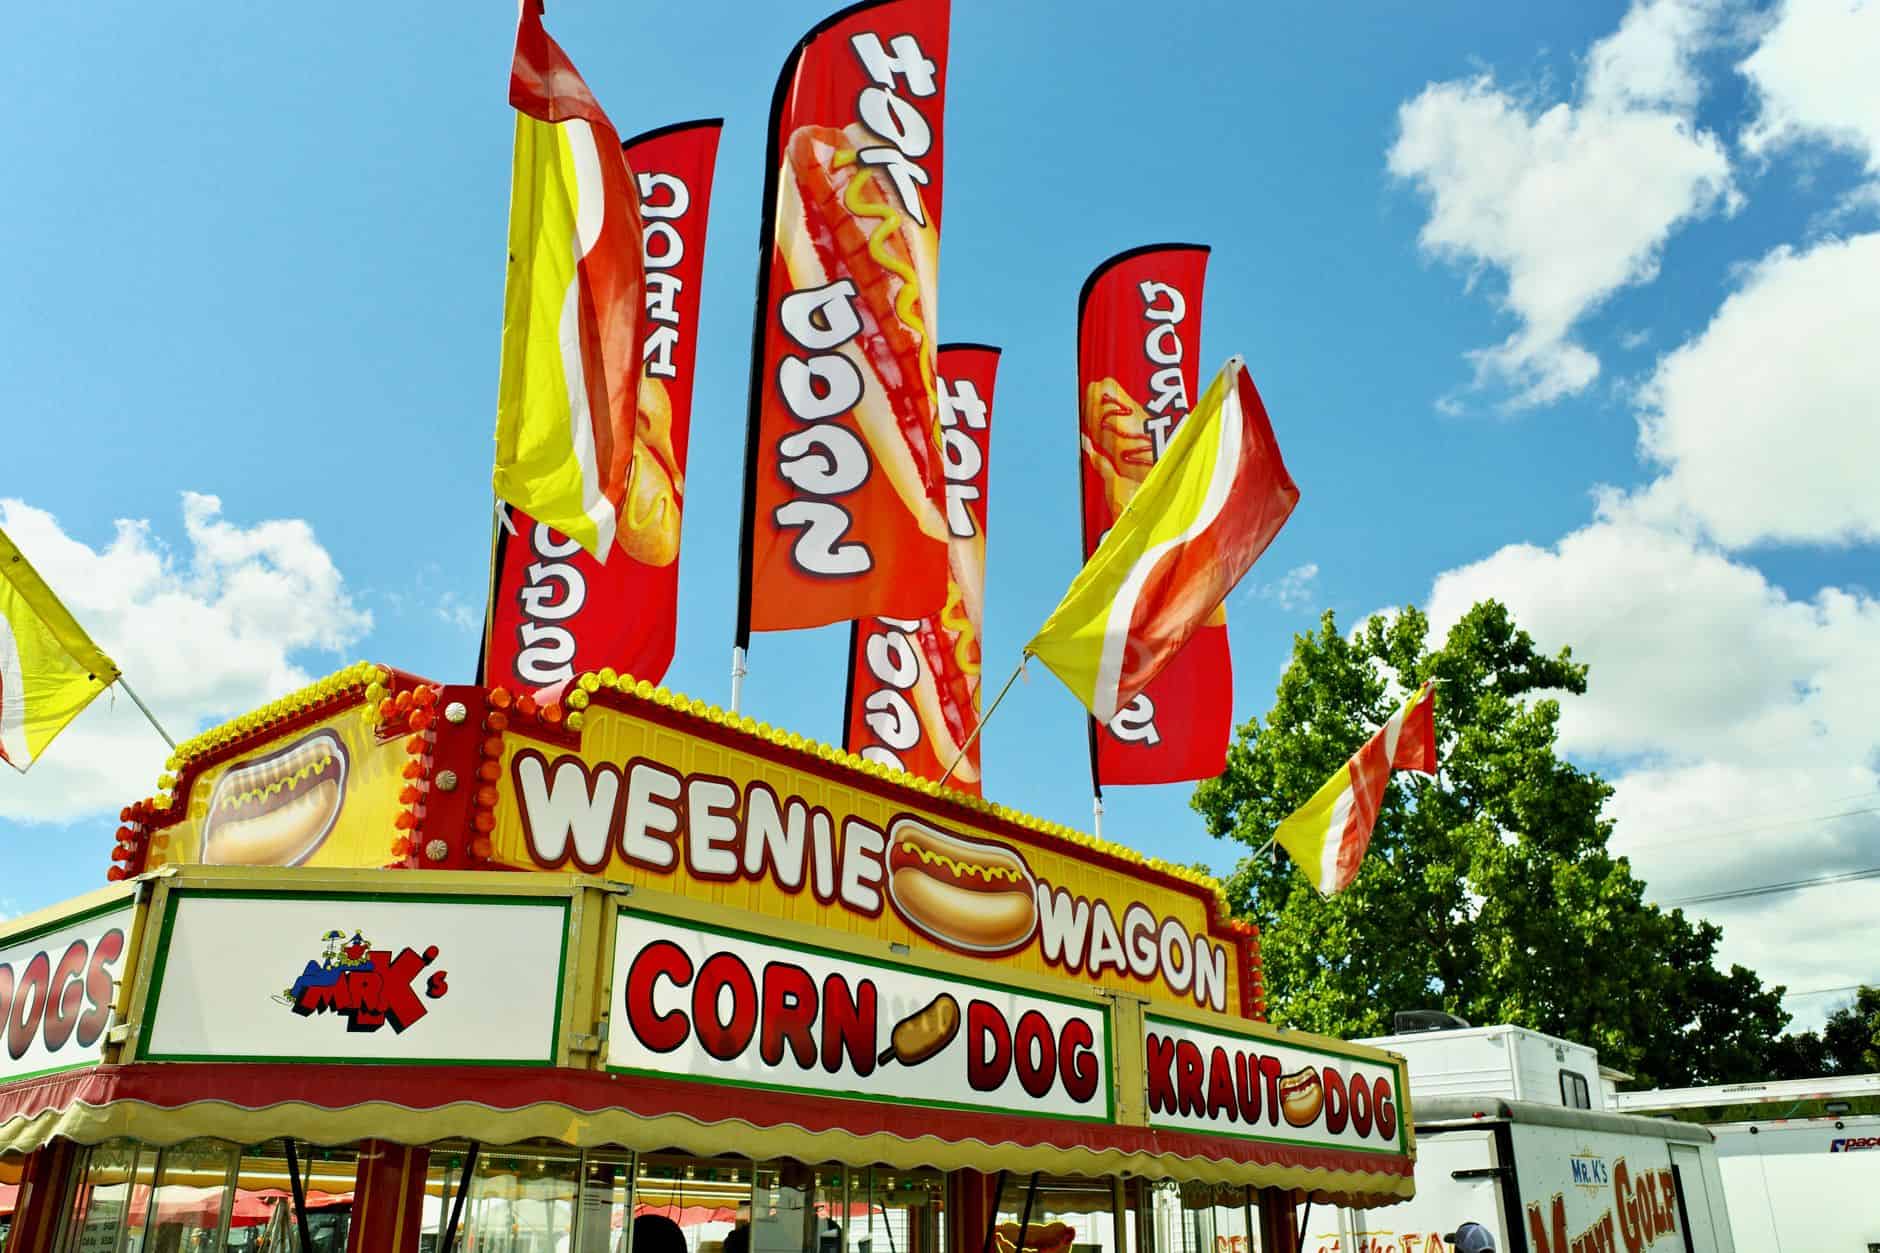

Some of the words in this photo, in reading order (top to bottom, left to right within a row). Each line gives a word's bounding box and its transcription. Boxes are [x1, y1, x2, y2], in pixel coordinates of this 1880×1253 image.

[511, 750, 888, 915] WEENIE
[1034, 881, 1229, 1013] WAGON
[624, 939, 878, 1077] CORN
[966, 999, 1099, 1103] DOG
[1146, 1032, 1282, 1128] KRAUT
[1323, 1066, 1397, 1142] DOG
